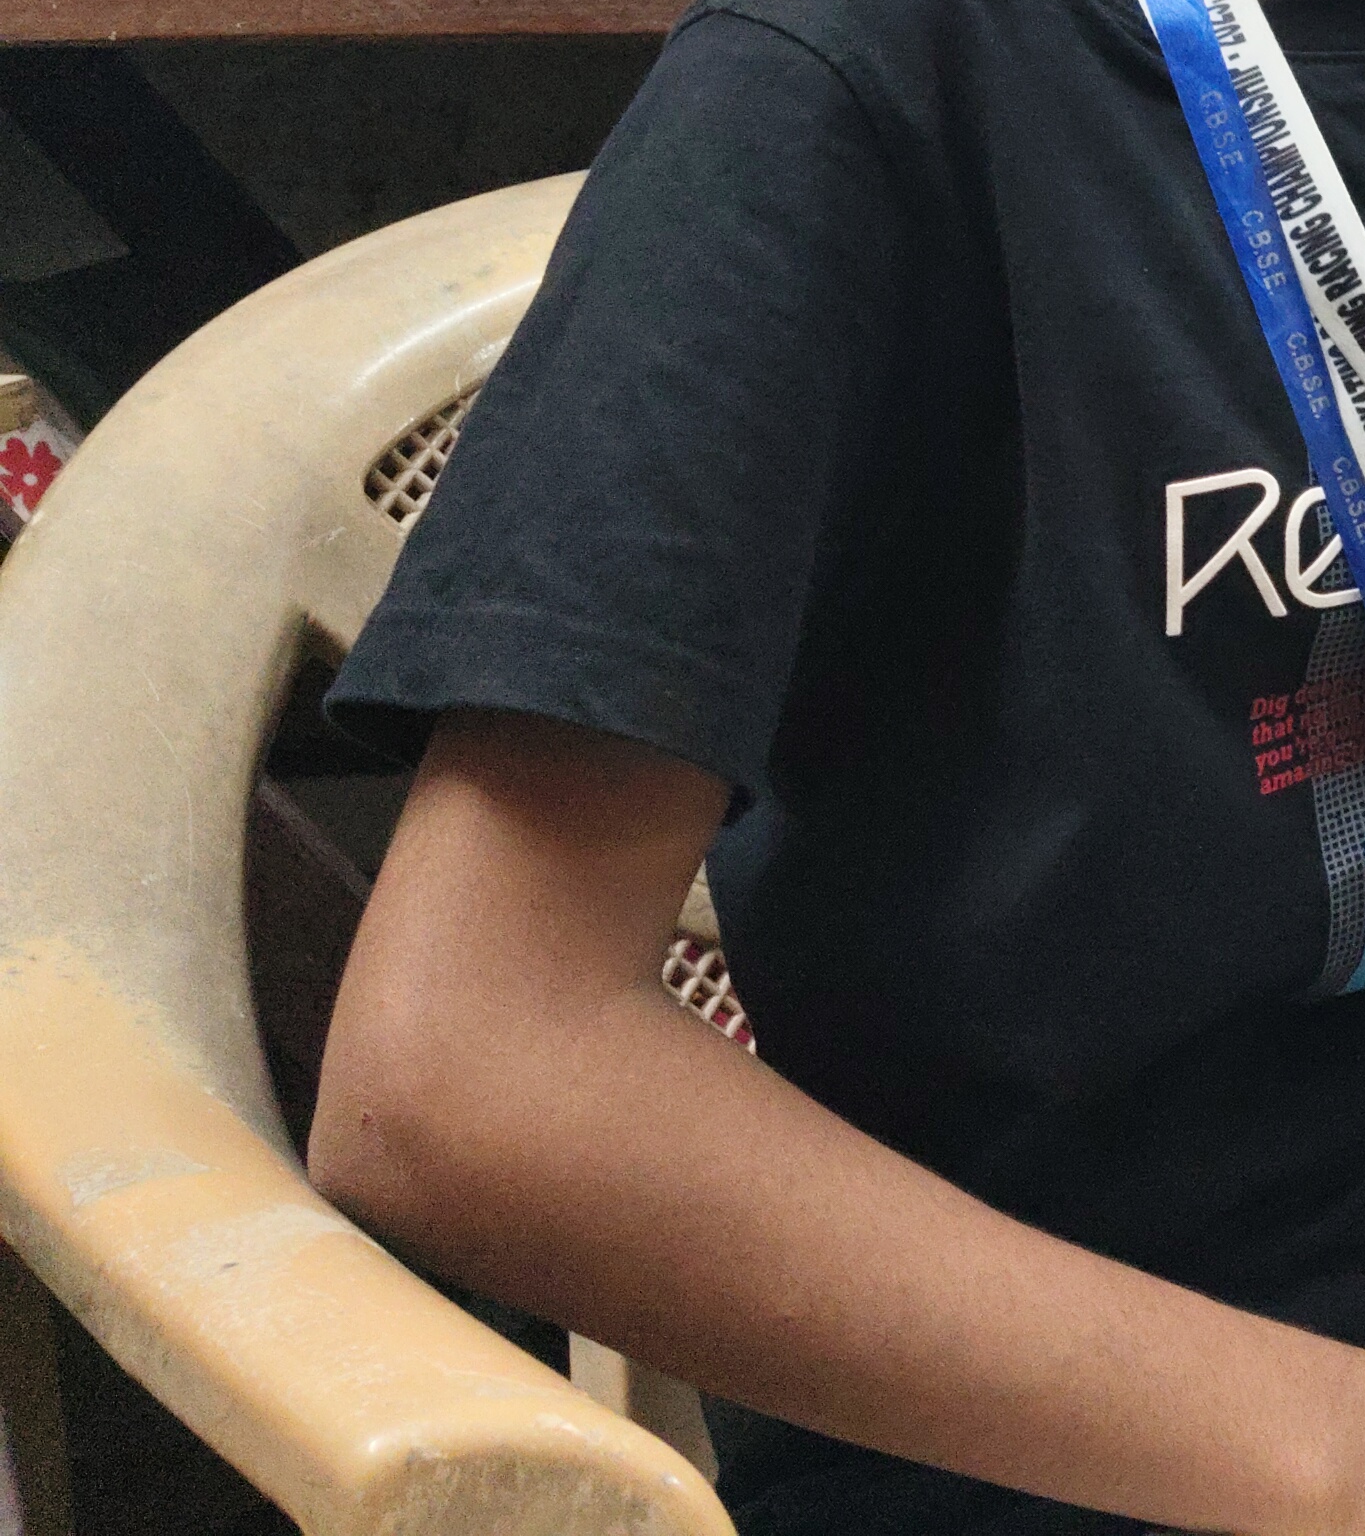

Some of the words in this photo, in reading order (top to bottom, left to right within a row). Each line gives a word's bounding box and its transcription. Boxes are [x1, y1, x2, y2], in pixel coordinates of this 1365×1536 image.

[1228, 64, 1323, 222] CHAMPIONSHIP
[1288, 211, 1364, 304] RACING
[1250, 695, 1290, 721] Dig
[1252, 714, 1295, 746] that
